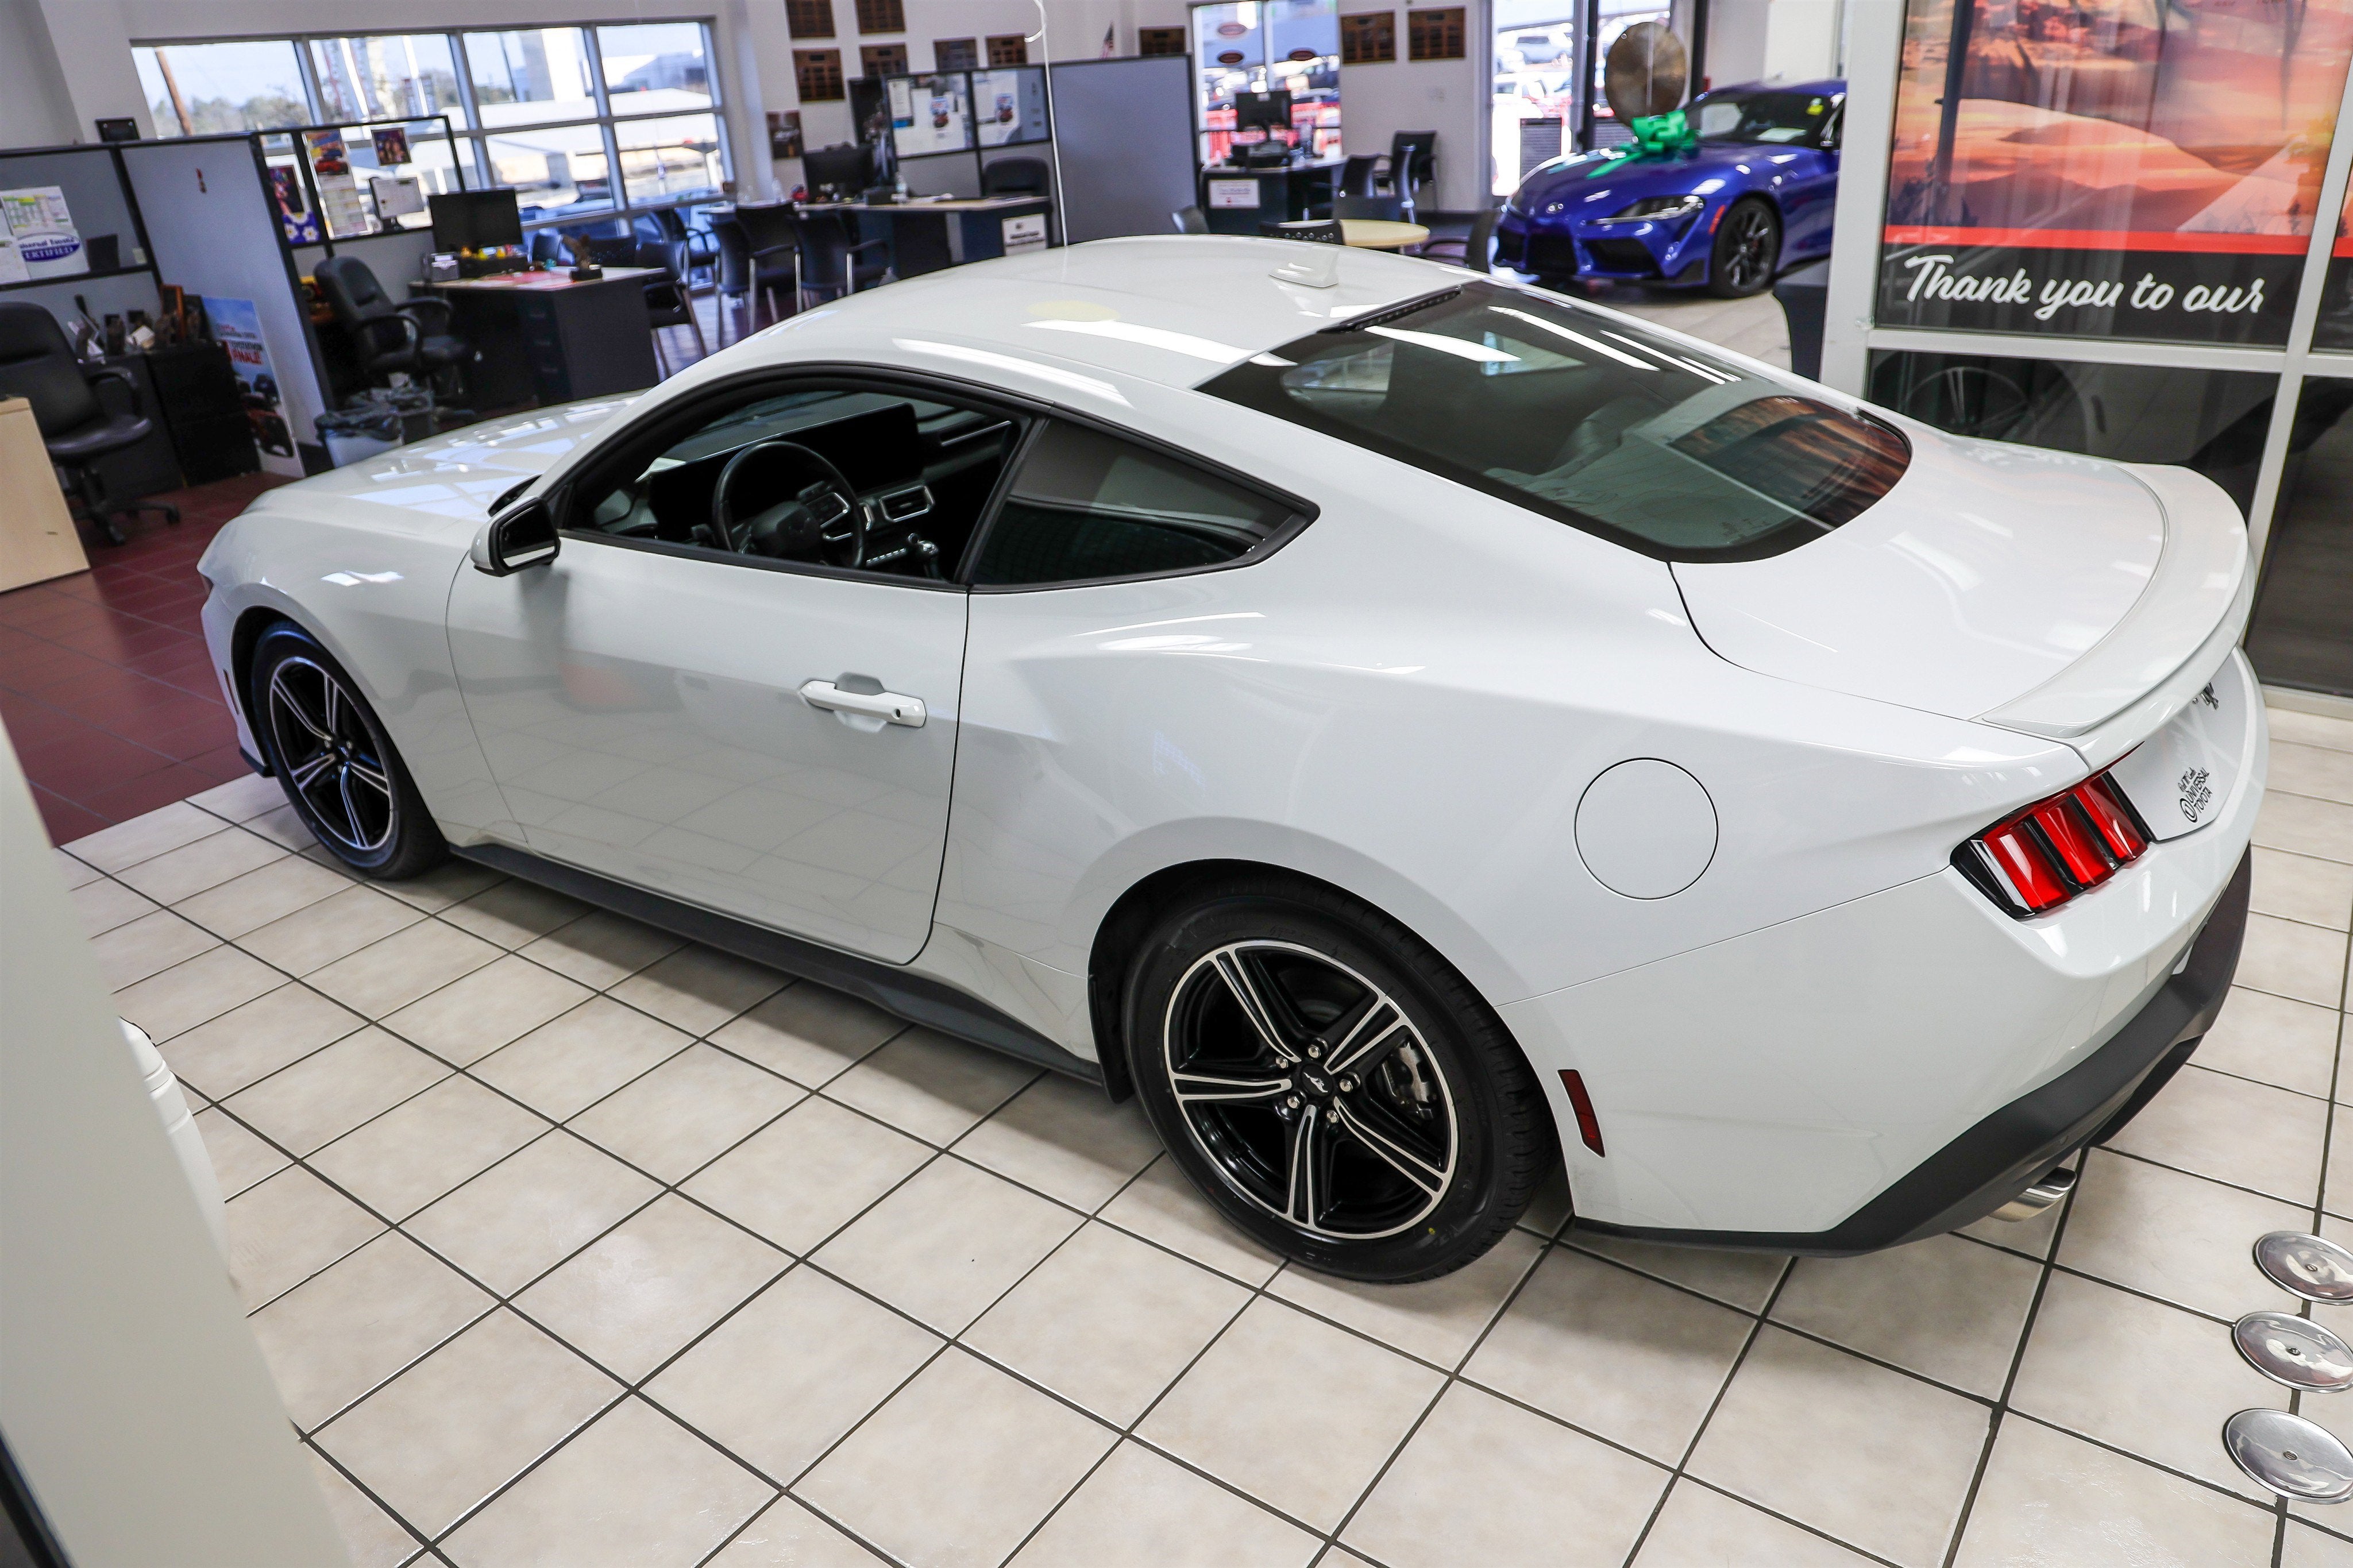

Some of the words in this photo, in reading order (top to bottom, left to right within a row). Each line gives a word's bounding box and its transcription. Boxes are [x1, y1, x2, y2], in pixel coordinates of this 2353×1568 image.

[1904, 254, 2032, 304] Thank
[2034, 279, 2124, 321] you
[2130, 272, 2174, 311] to
[2182, 277, 2265, 314] our
[2185, 767, 2211, 804] UNIVERSAL
[2193, 786, 2213, 814] TOYOTA
